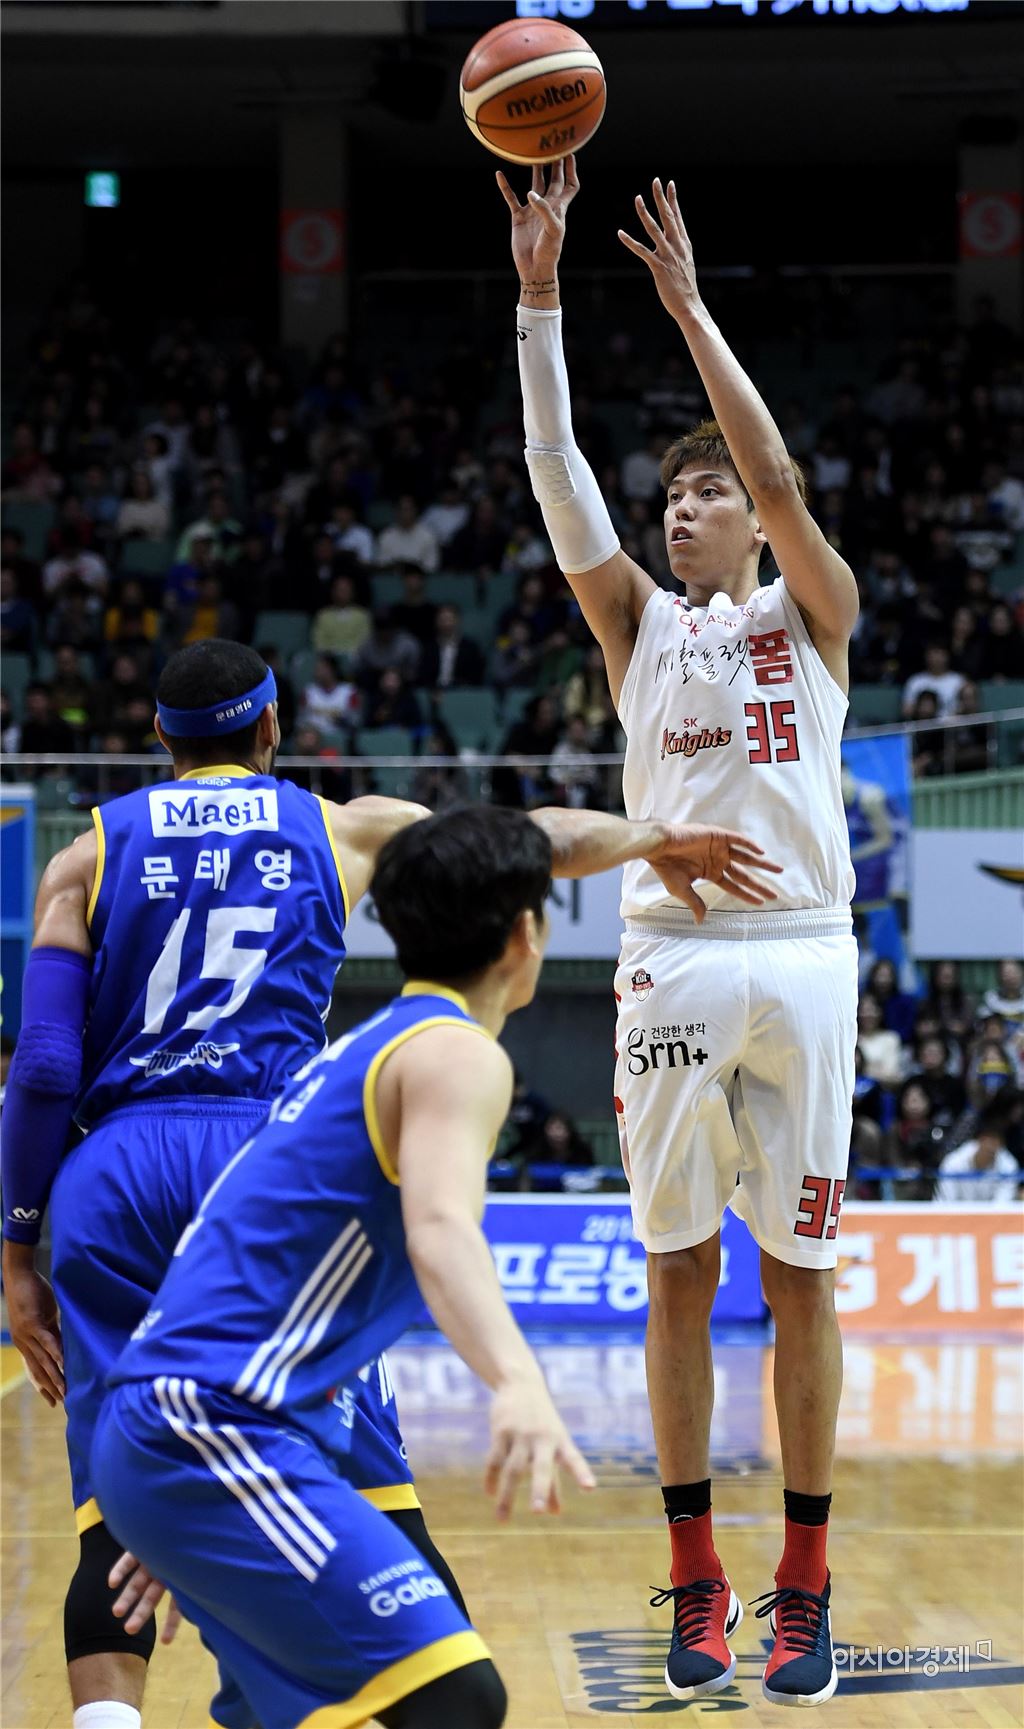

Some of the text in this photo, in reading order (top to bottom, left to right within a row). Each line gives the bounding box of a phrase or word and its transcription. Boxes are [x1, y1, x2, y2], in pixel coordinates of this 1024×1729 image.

[506, 78, 588, 118] molten
[683, 717, 699, 729] SK
[744, 699, 801, 765] 35
[660, 726, 733, 761] Knights
[161, 795, 269, 829] Maeil
[140, 905, 278, 1035] 15
[650, 1021, 706, 1040] 건강한 생각
